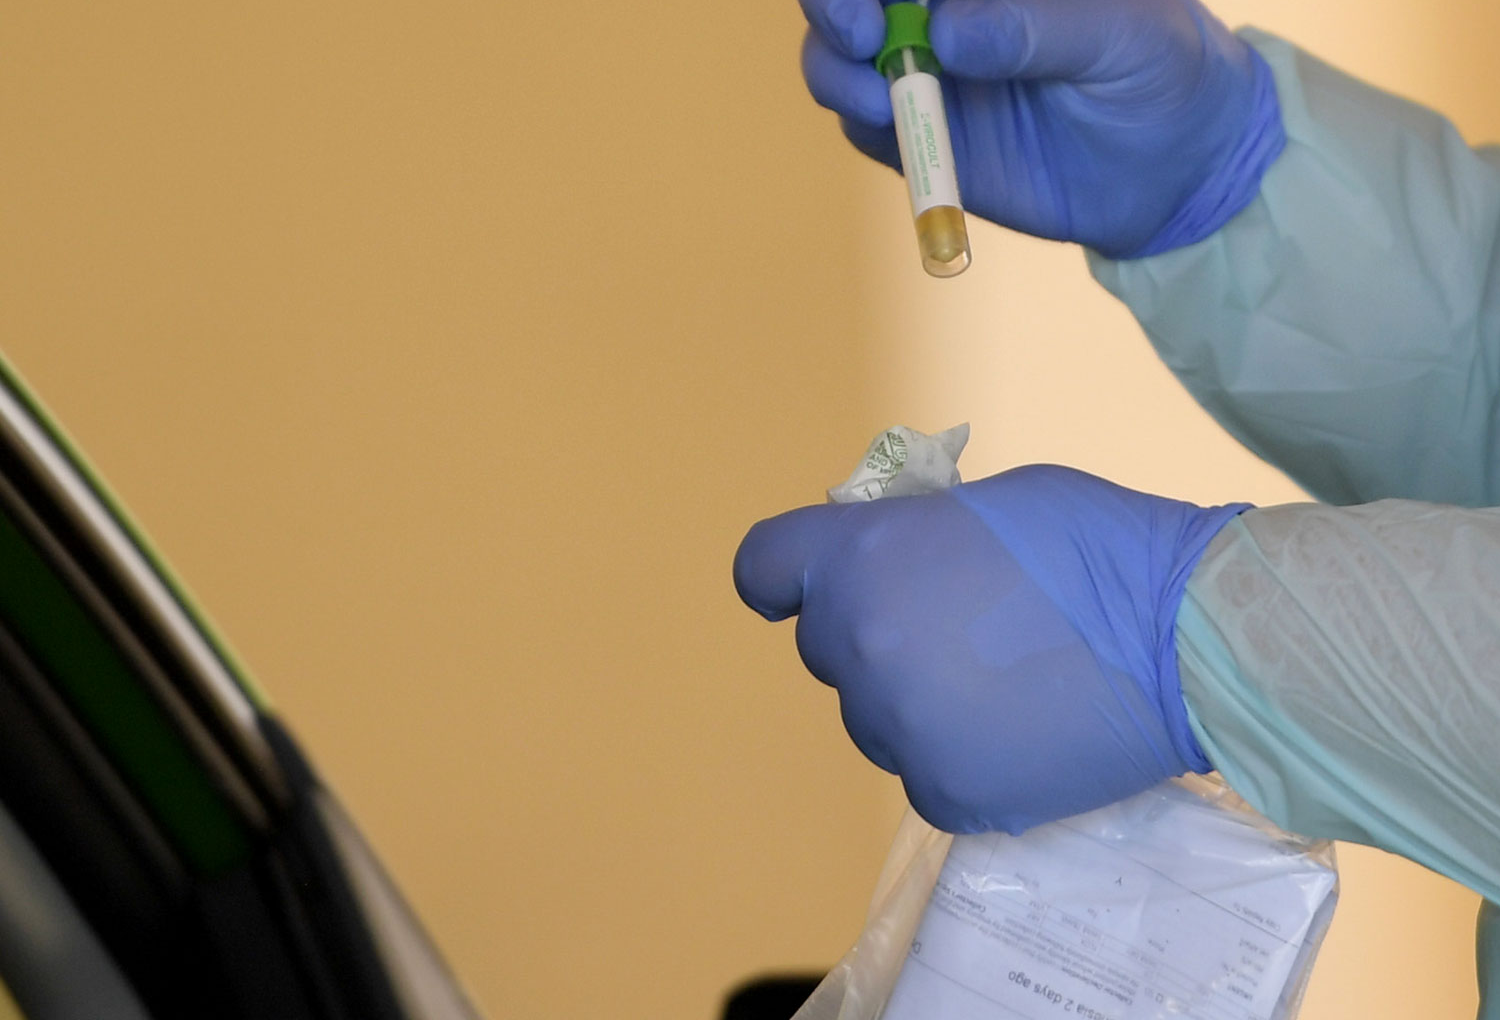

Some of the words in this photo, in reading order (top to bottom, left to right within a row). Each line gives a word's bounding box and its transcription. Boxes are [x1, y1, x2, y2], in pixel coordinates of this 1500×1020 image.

[1008, 970, 1032, 989] ago
[1033, 983, 1063, 1005] days
[1063, 998, 1074, 1012] 2
